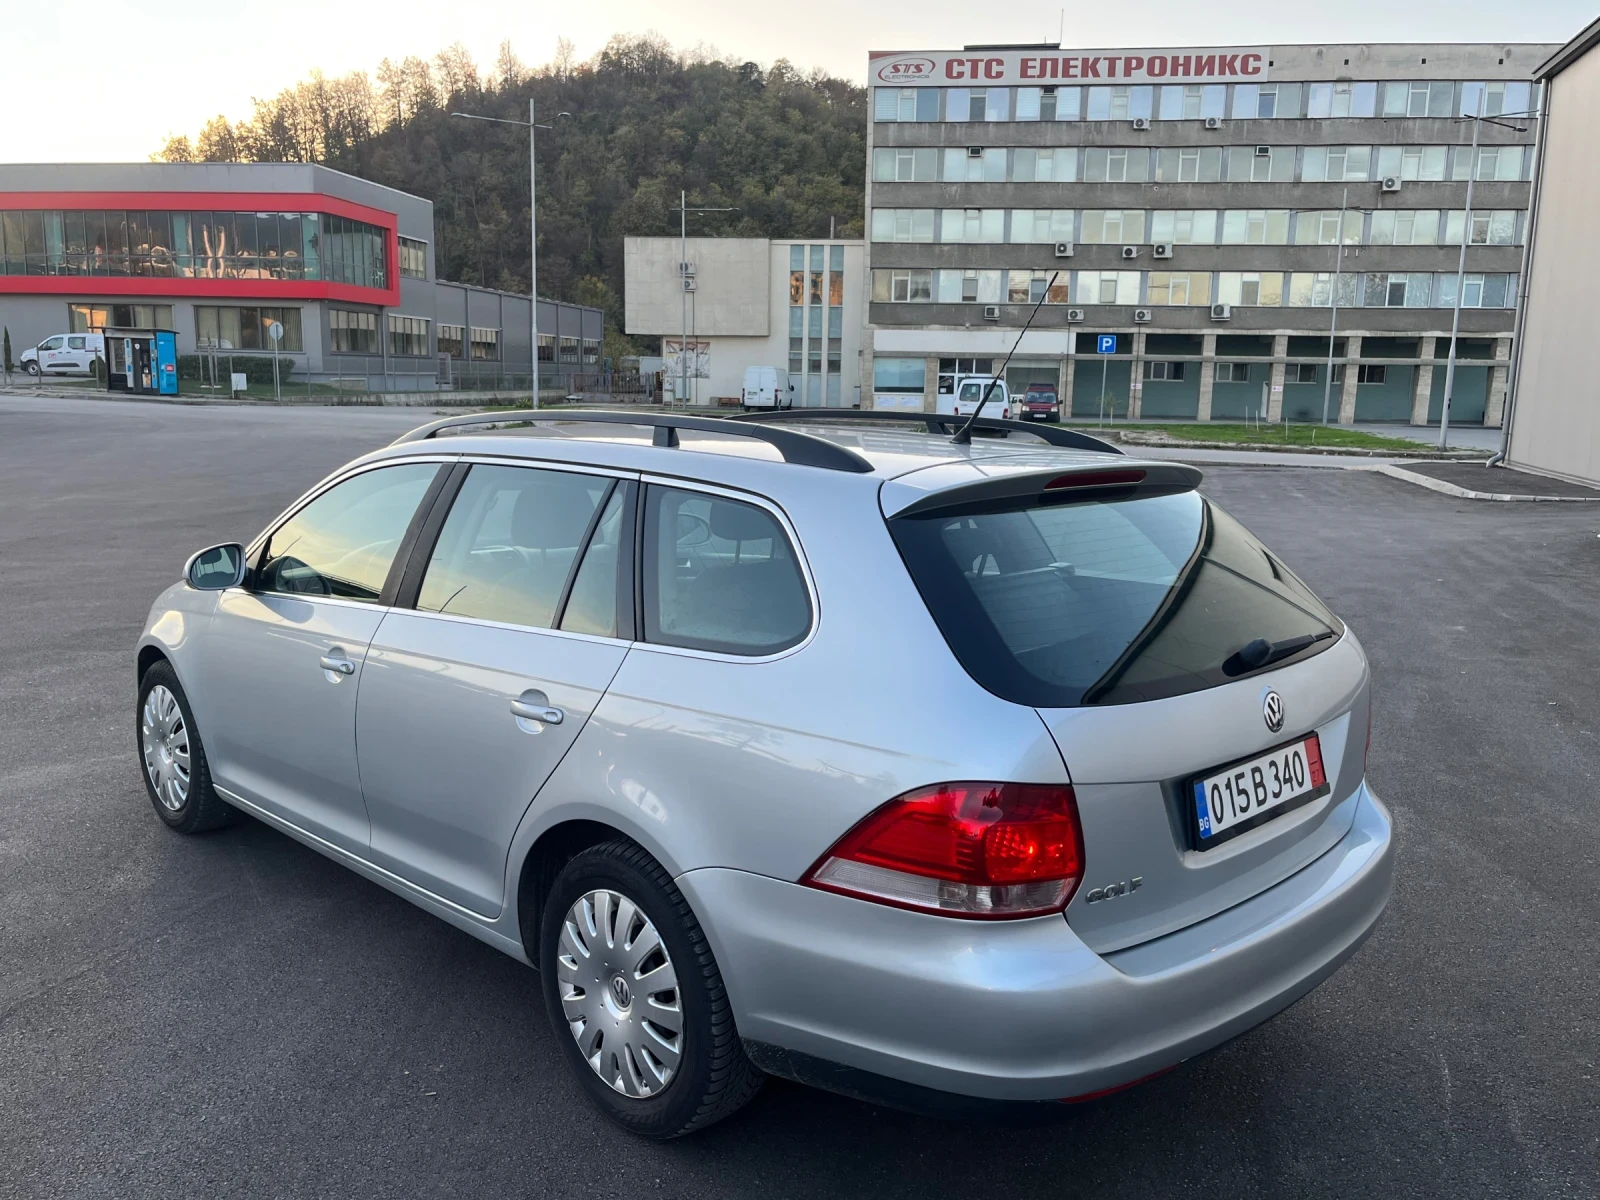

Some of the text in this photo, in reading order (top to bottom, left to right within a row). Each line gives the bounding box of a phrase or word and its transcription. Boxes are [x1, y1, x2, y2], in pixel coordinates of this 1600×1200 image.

[889, 63, 925, 74] STS
[945, 53, 1262, 80] СТС ЕЛЕКТРОНИКС
[1102, 338, 1112, 351] P
[1199, 816, 1210, 832] BG
[1086, 876, 1143, 904] GOLF
